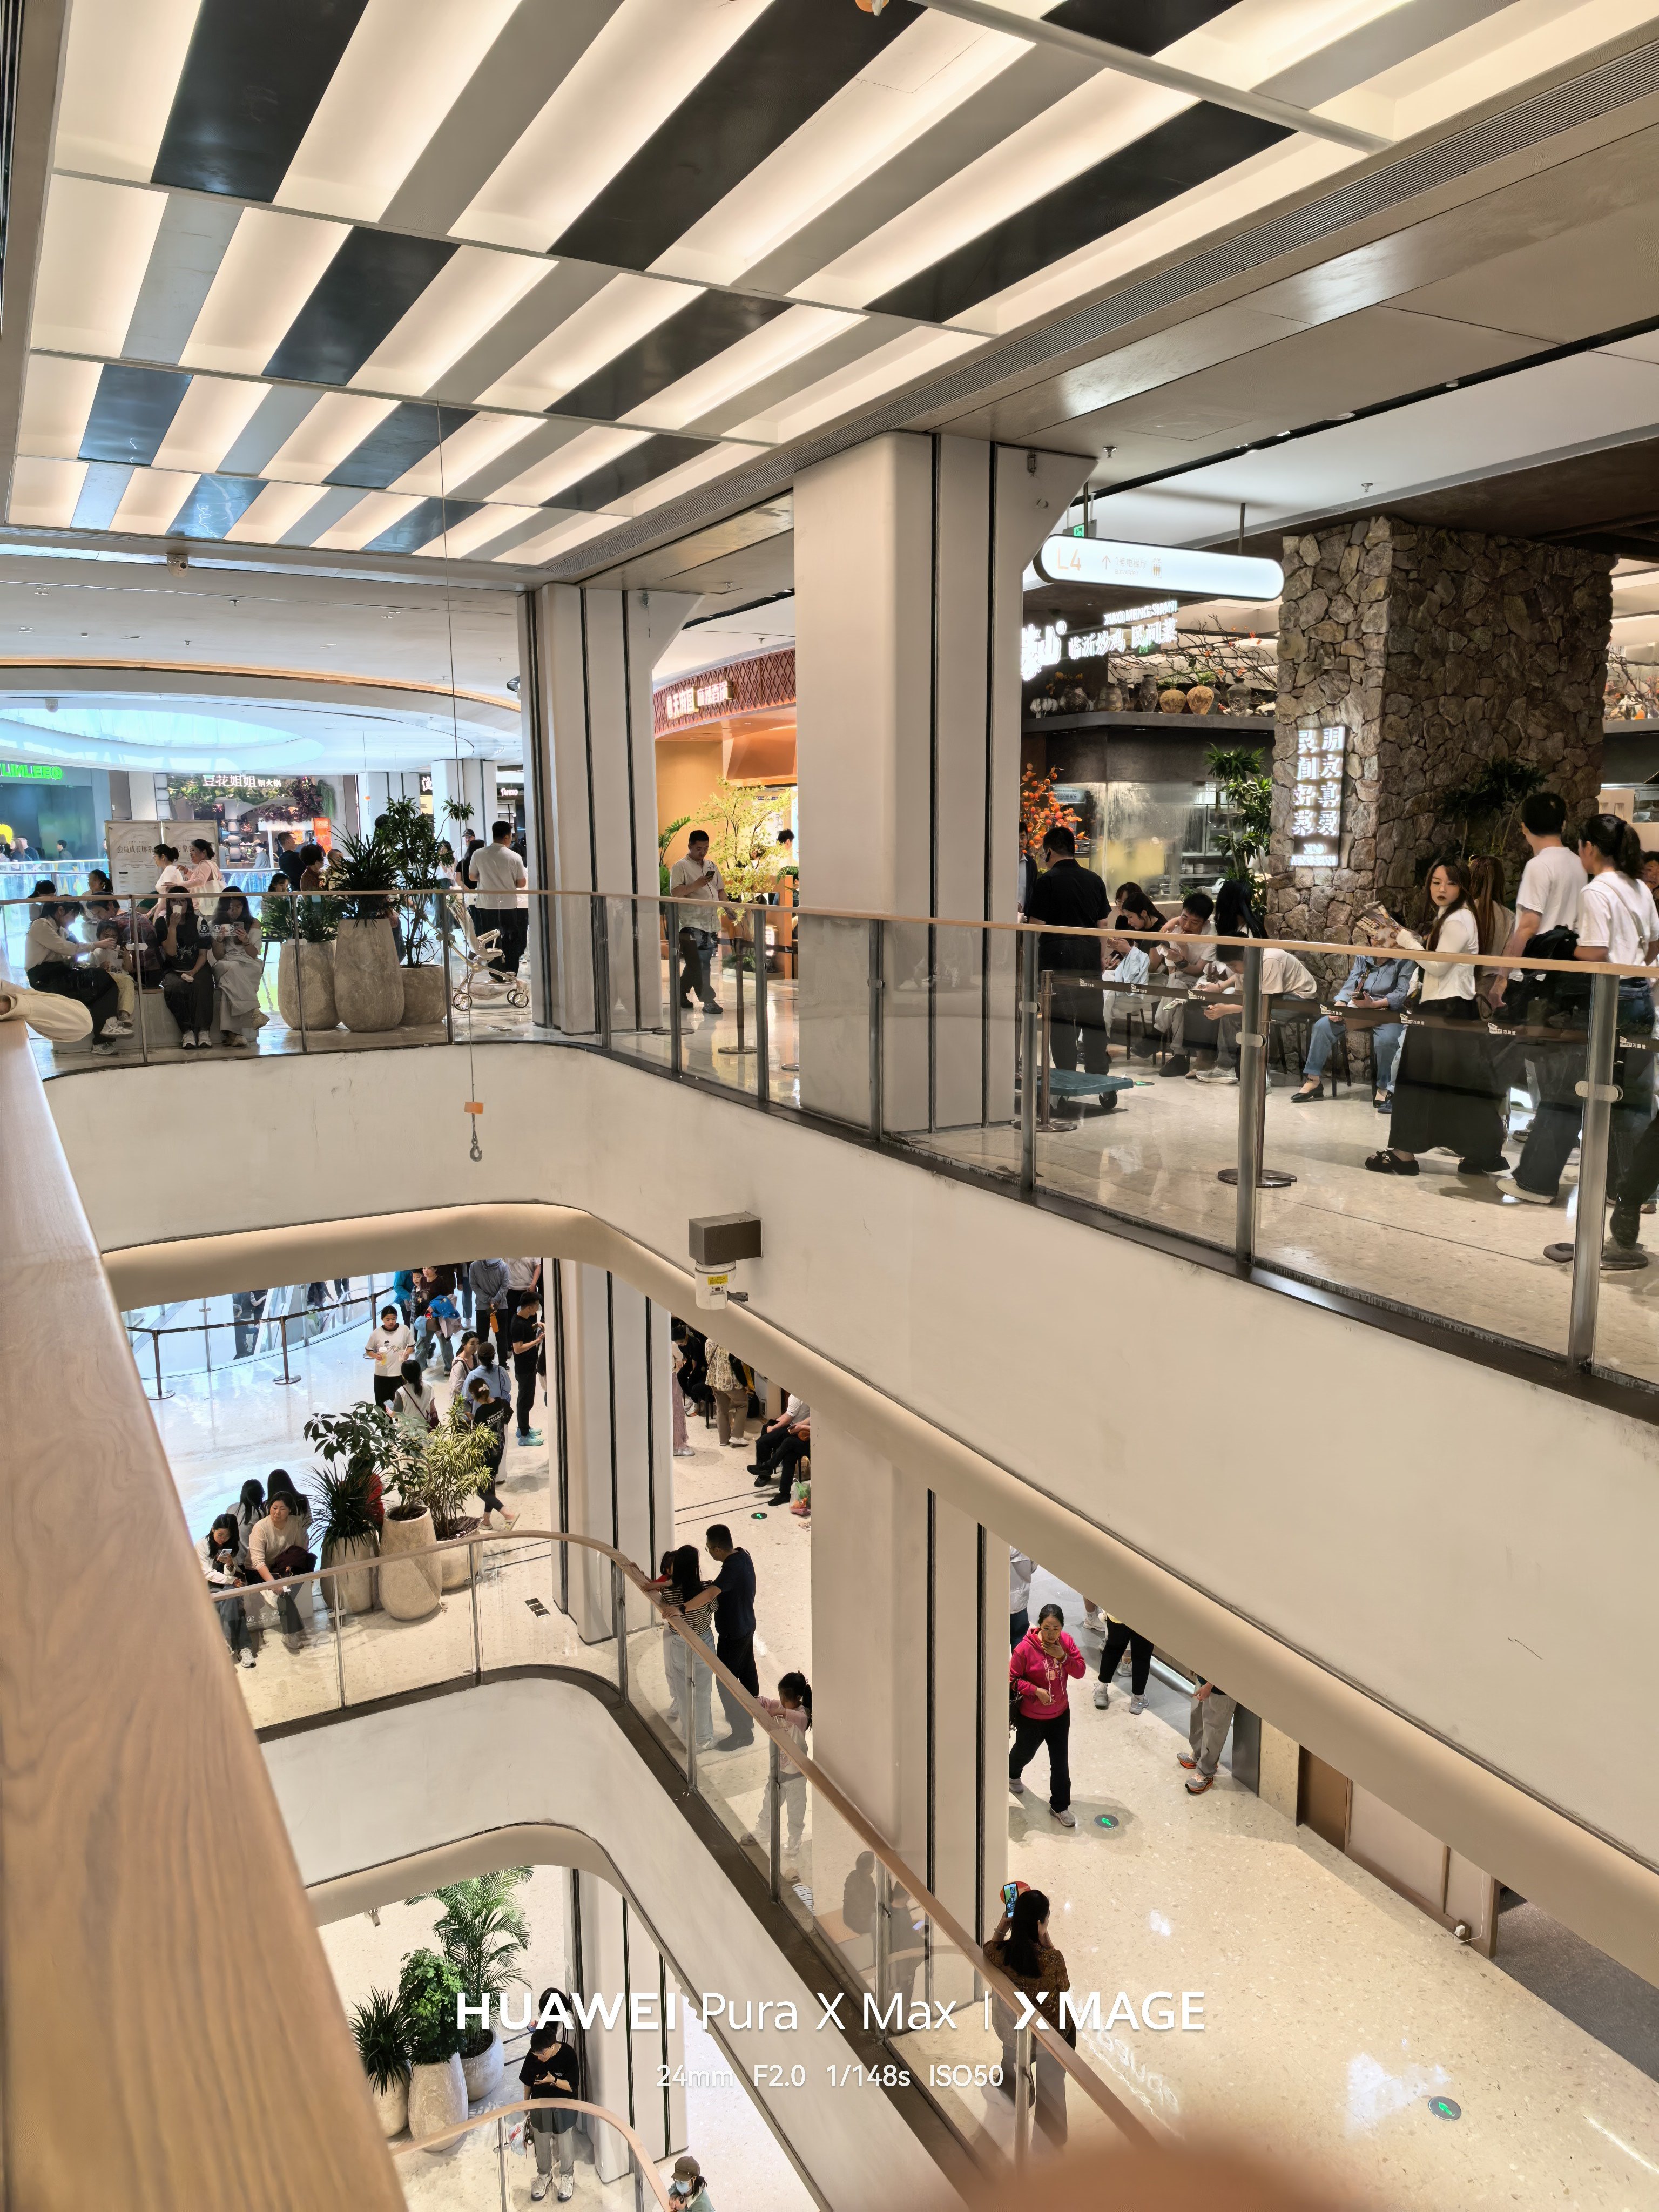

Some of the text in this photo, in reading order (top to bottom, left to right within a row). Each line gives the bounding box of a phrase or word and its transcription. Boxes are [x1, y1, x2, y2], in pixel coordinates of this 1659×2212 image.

[1057, 547, 1082, 571] L4
[1115, 557, 1147, 569] 1号电梯厅
[1068, 618, 1178, 660] 临沂炒鸡 民间菜
[203, 774, 257, 787] 豆花姐姐
[1291, 730, 1318, 837] 民间好菜
[1317, 726, 1345, 837] 朋友真爱
